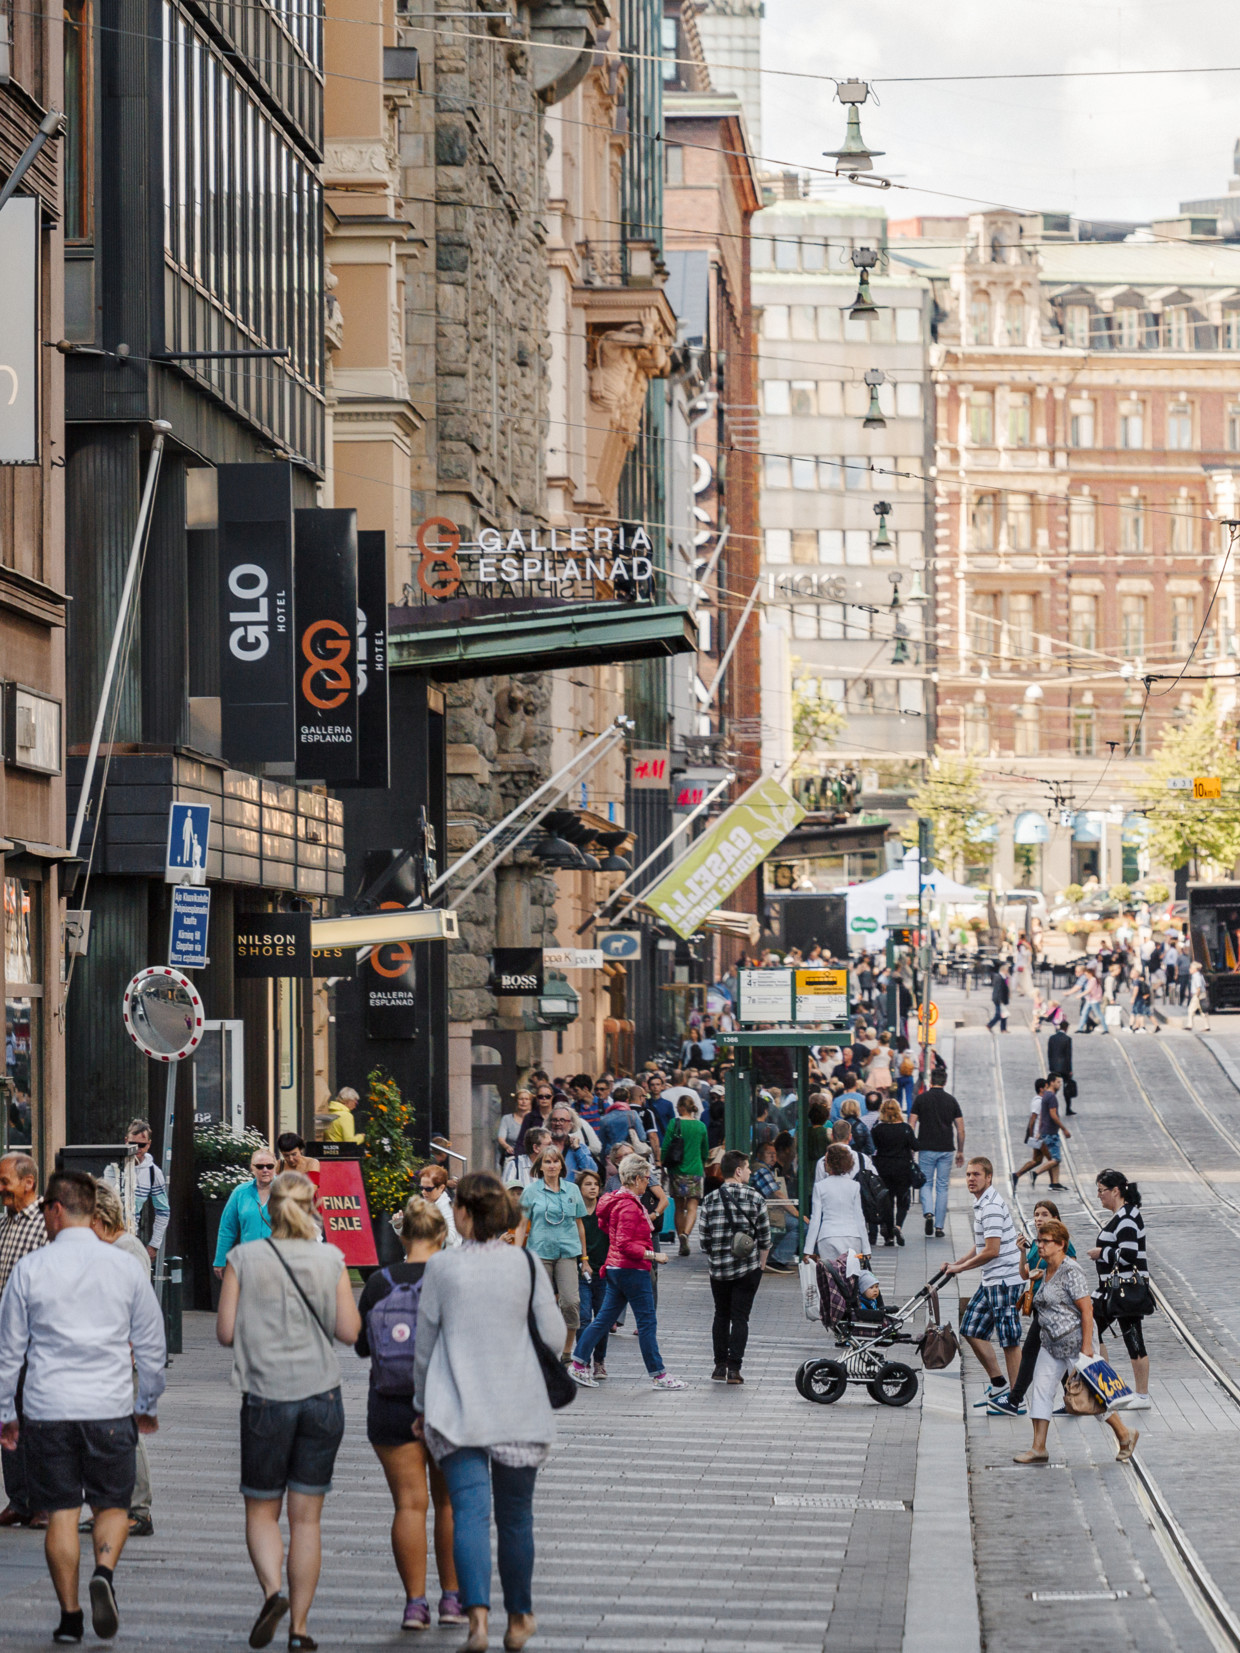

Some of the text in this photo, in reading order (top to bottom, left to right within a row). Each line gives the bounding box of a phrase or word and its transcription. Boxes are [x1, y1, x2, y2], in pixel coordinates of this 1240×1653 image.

[478, 526, 652, 552] GALLERIA
[478, 556, 653, 582] ESPLANAD
[228, 563, 270, 661] GLO
[277, 589, 286, 632] HOTEL
[374, 630, 384, 671] HOTEL
[300, 725, 353, 734] GALLERIA
[300, 734, 353, 743] ESPLANAD
[238, 934, 296, 945] NILSON
[238, 945, 296, 957] SHOES
[501, 974, 537, 986] BOSS
[369, 991, 413, 999] GALLERIA
[322, 1196, 361, 1210] FINAL
[329, 1217, 362, 1231] SALE
